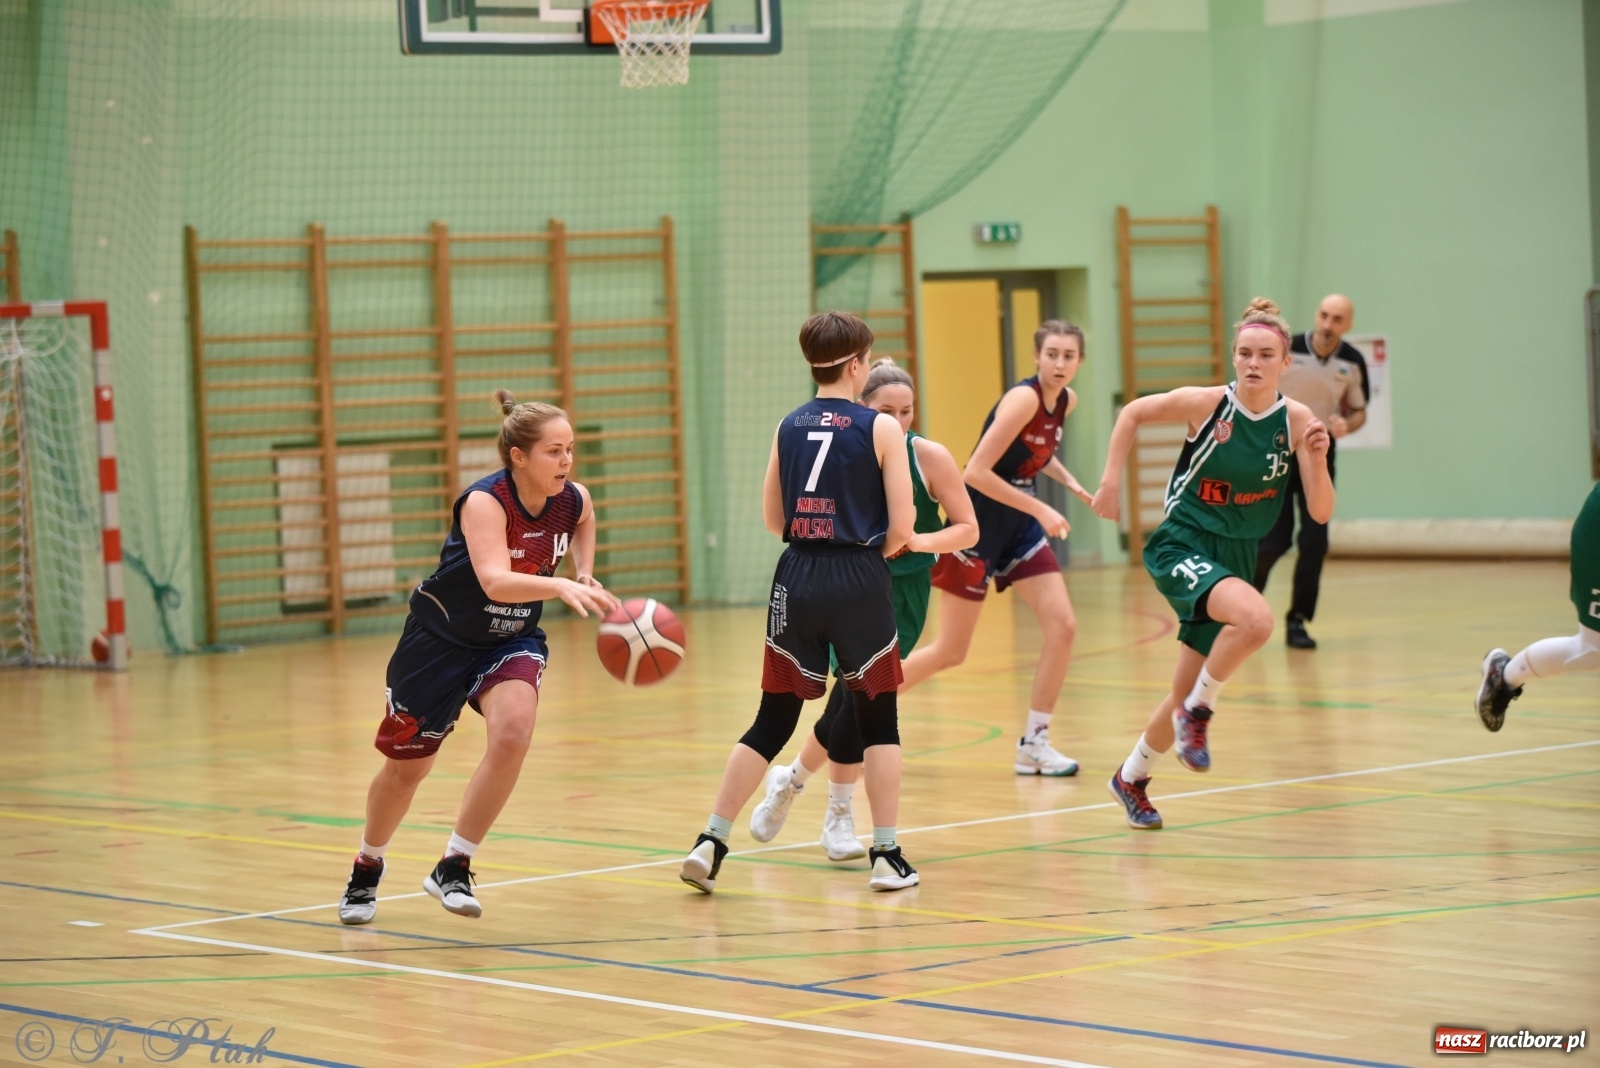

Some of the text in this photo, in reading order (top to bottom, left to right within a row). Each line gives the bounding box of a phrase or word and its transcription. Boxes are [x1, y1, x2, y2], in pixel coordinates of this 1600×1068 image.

[804, 431, 834, 492] 7
[1262, 450, 1290, 481] 35
[790, 517, 835, 539] POLSKA
[551, 532, 568, 565] 14
[1171, 555, 1213, 590] 35
